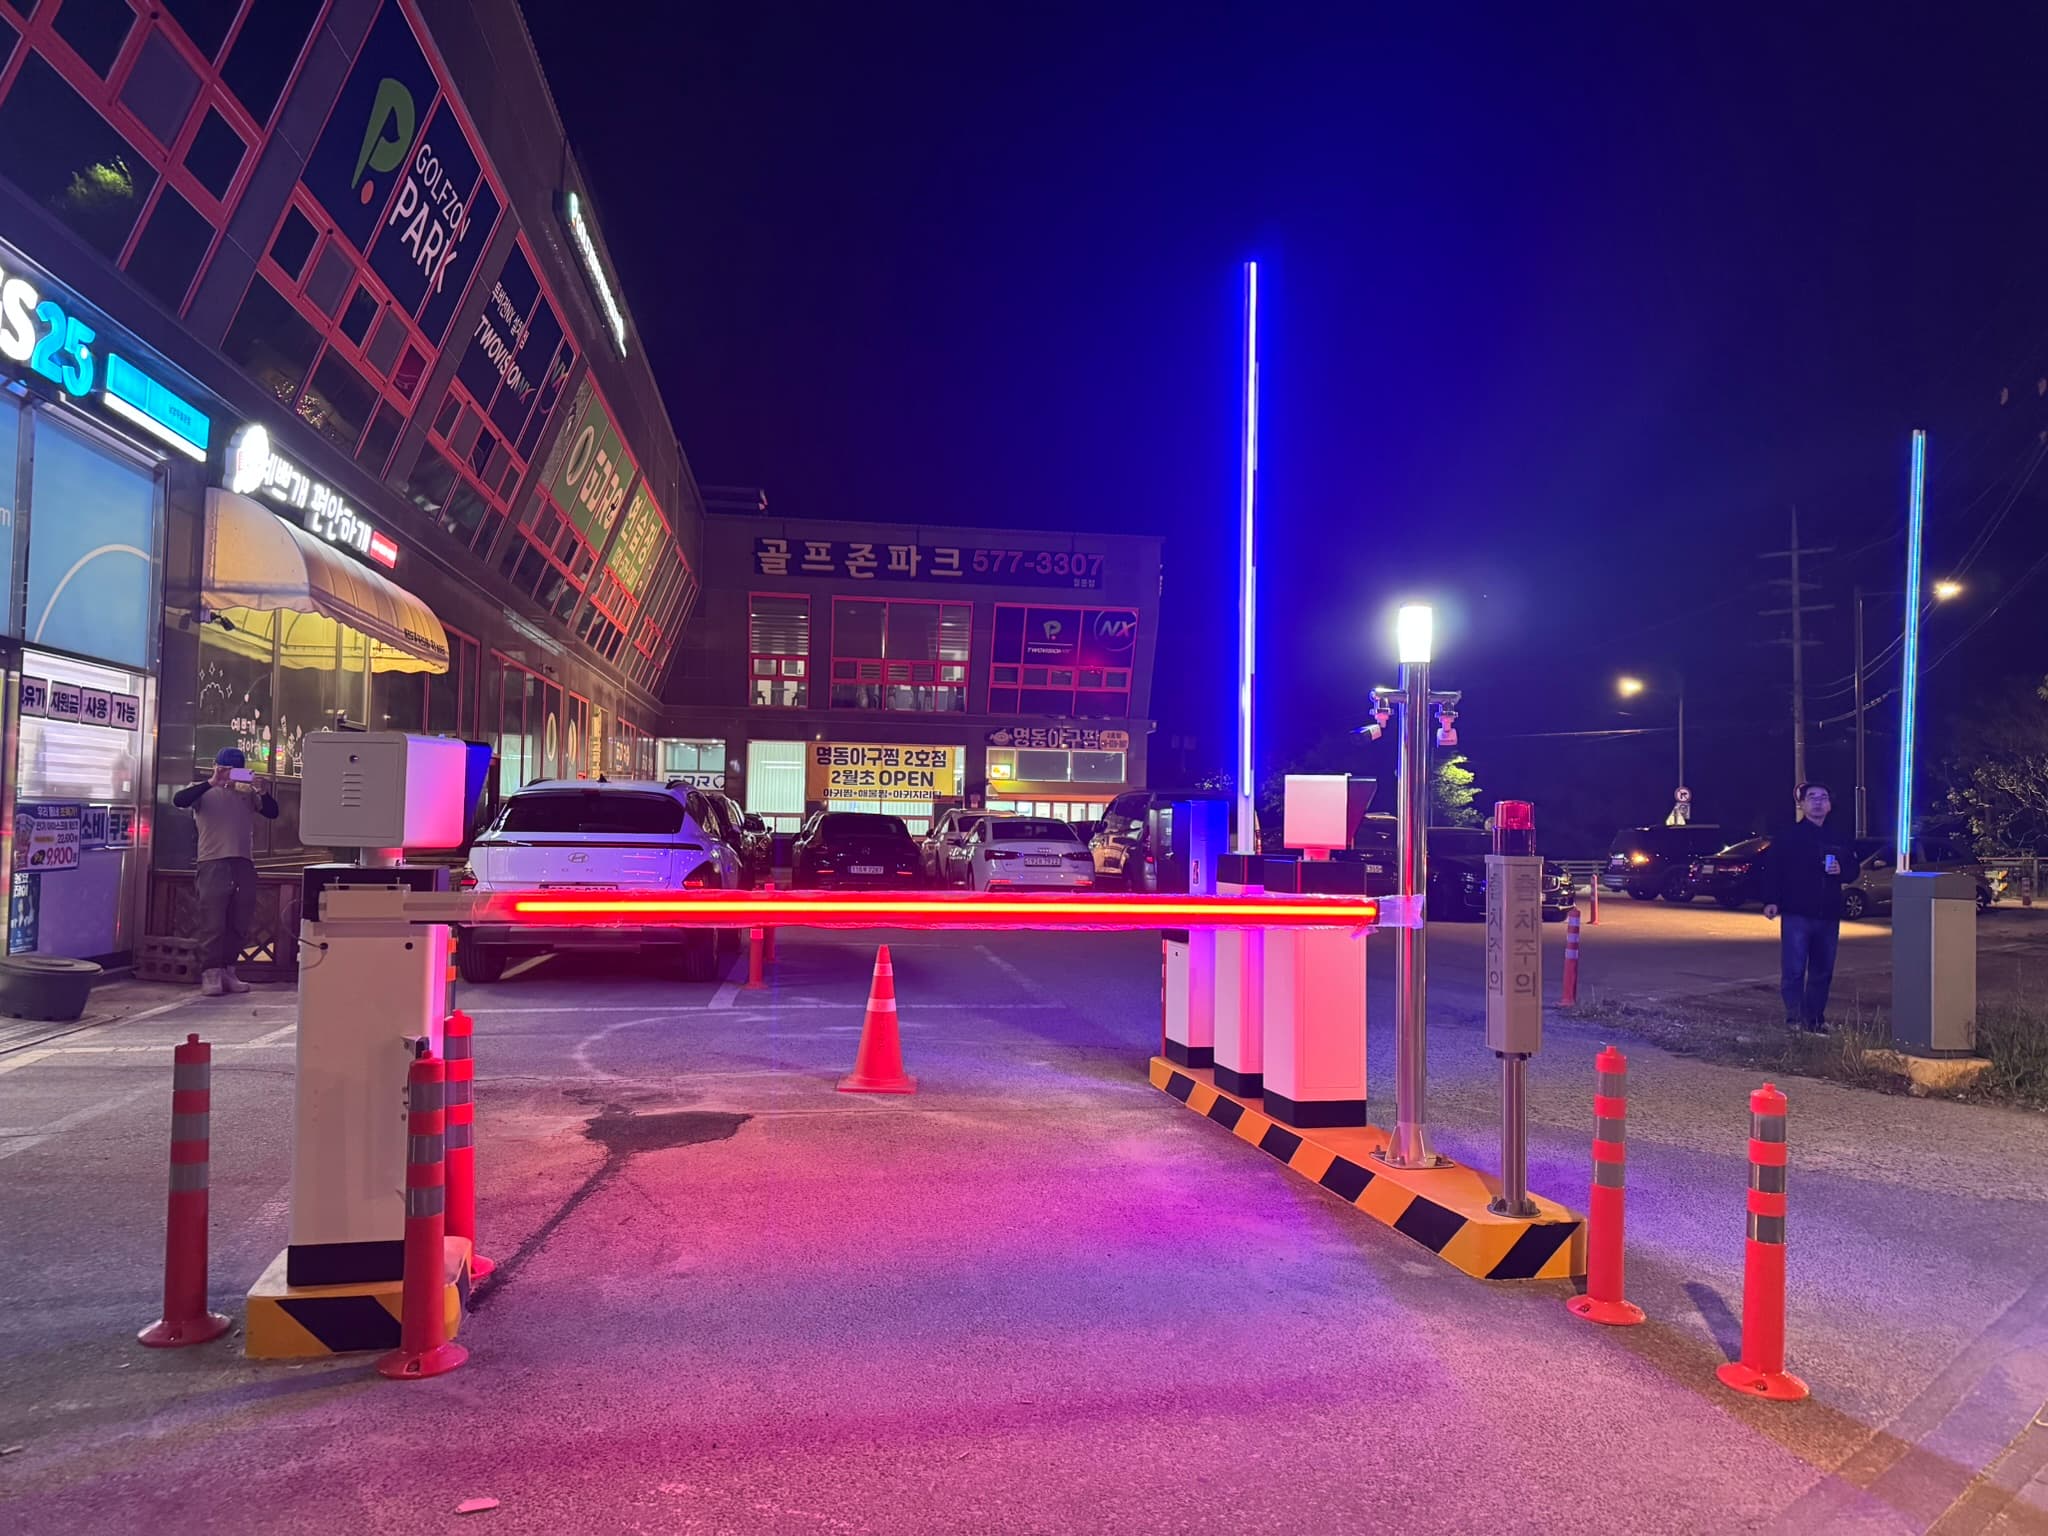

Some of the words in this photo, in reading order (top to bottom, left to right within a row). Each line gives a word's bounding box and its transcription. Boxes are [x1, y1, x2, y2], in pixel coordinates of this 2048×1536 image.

[415, 144, 471, 242] GOLFZON
[388, 175, 457, 293] PARK
[621, 495, 657, 565] 연습장
[757, 538, 964, 579] 골프존파크
[972, 549, 1105, 577] 577-3307
[51, 690, 80, 714] 지원금
[86, 696, 108, 719] 사용
[116, 701, 136, 723] 가능
[816, 746, 899, 767] 명동아구찜
[904, 750, 947, 768] 2호점
[1013, 727, 1099, 750] 명동아구찜
[831, 769, 875, 786] 2월초
[878, 770, 934, 787] OPEN
[81, 812, 105, 840] 소비
[1513, 873, 1538, 997] 출차주의
